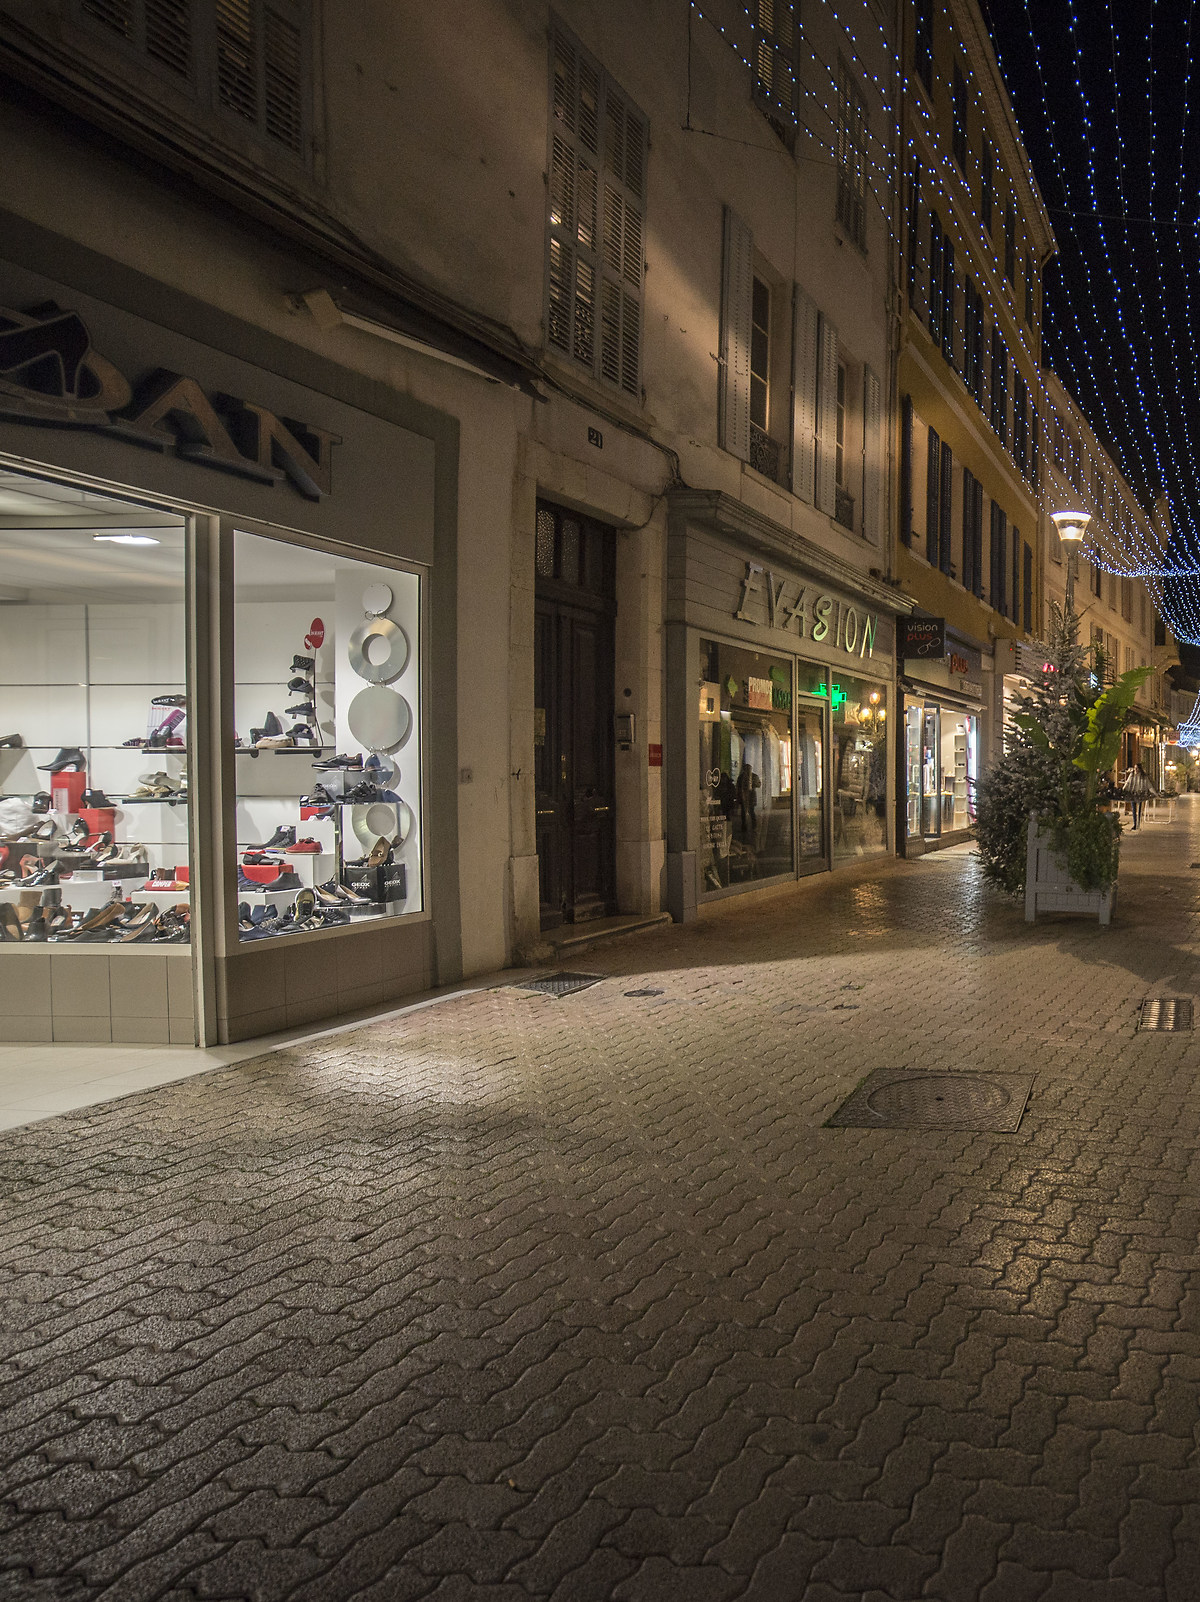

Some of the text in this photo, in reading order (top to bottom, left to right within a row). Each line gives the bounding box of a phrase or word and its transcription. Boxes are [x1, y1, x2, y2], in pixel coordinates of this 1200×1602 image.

[737, 561, 878, 658] EVASION
[907, 622, 938, 632] vision
[907, 633, 933, 642] plus
